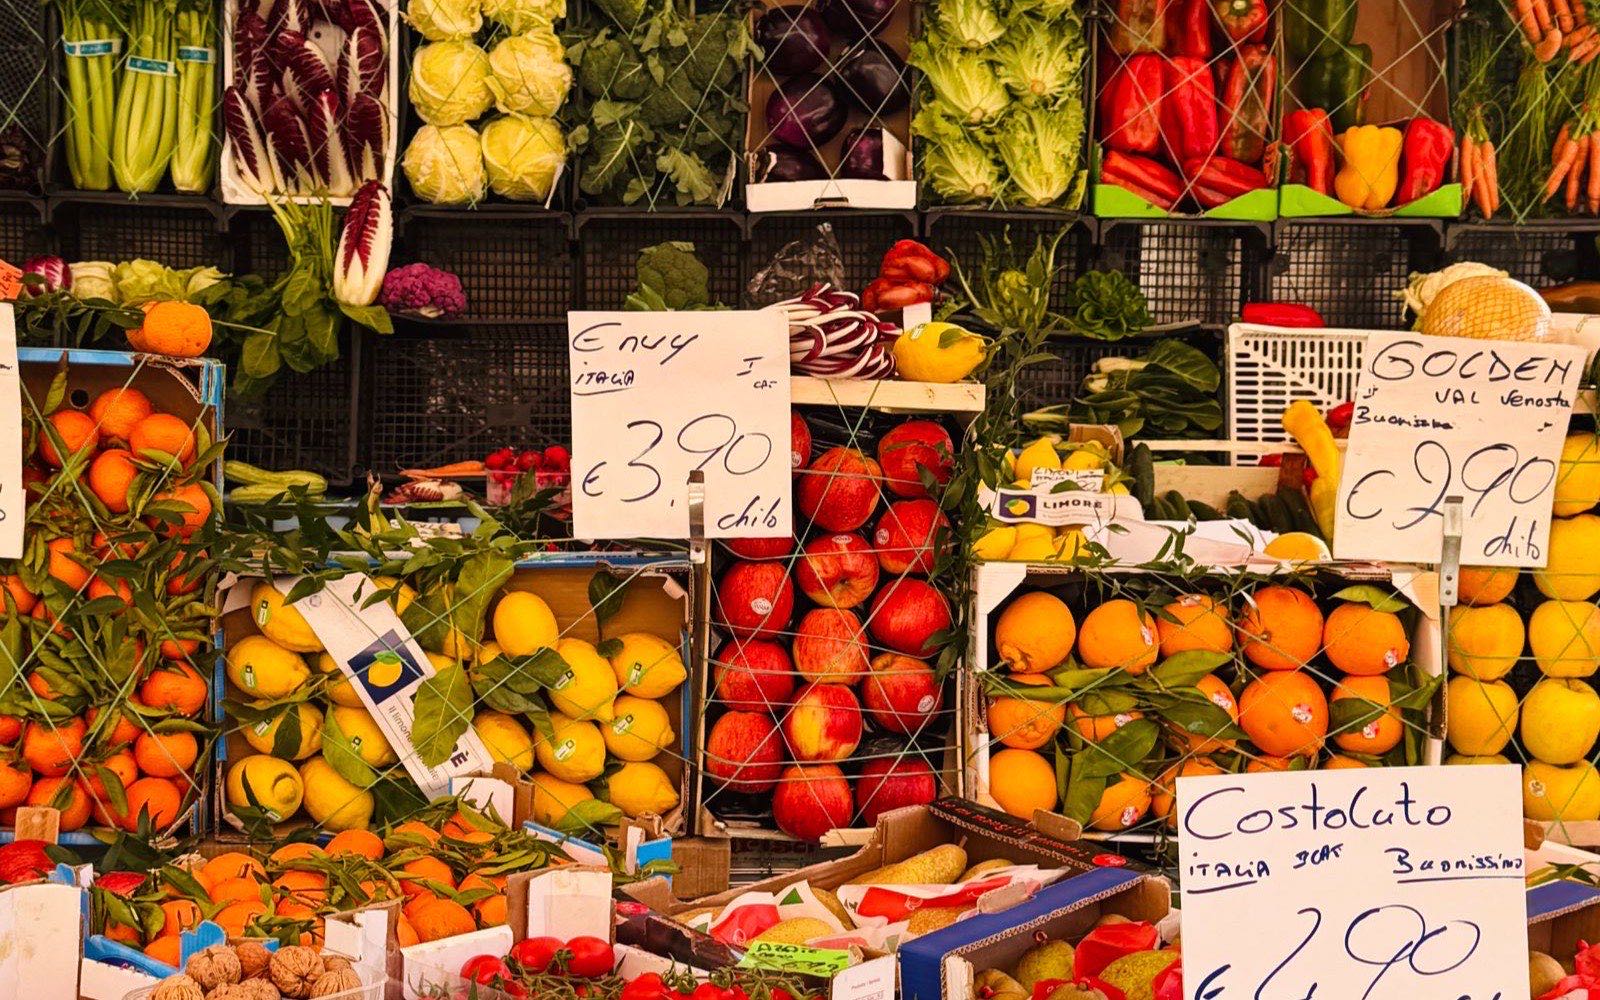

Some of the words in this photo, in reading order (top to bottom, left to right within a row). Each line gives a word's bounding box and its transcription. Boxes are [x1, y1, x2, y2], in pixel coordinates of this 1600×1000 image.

[572, 322, 699, 365] Envy
[1369, 340, 1572, 384] GOLDEN
[1435, 388, 1480, 404] VAL
[1500, 389, 1571, 408] Venosta
[582, 461, 607, 497] €
[717, 495, 781, 530] chilo
[1184, 782, 1452, 840] Costolato
